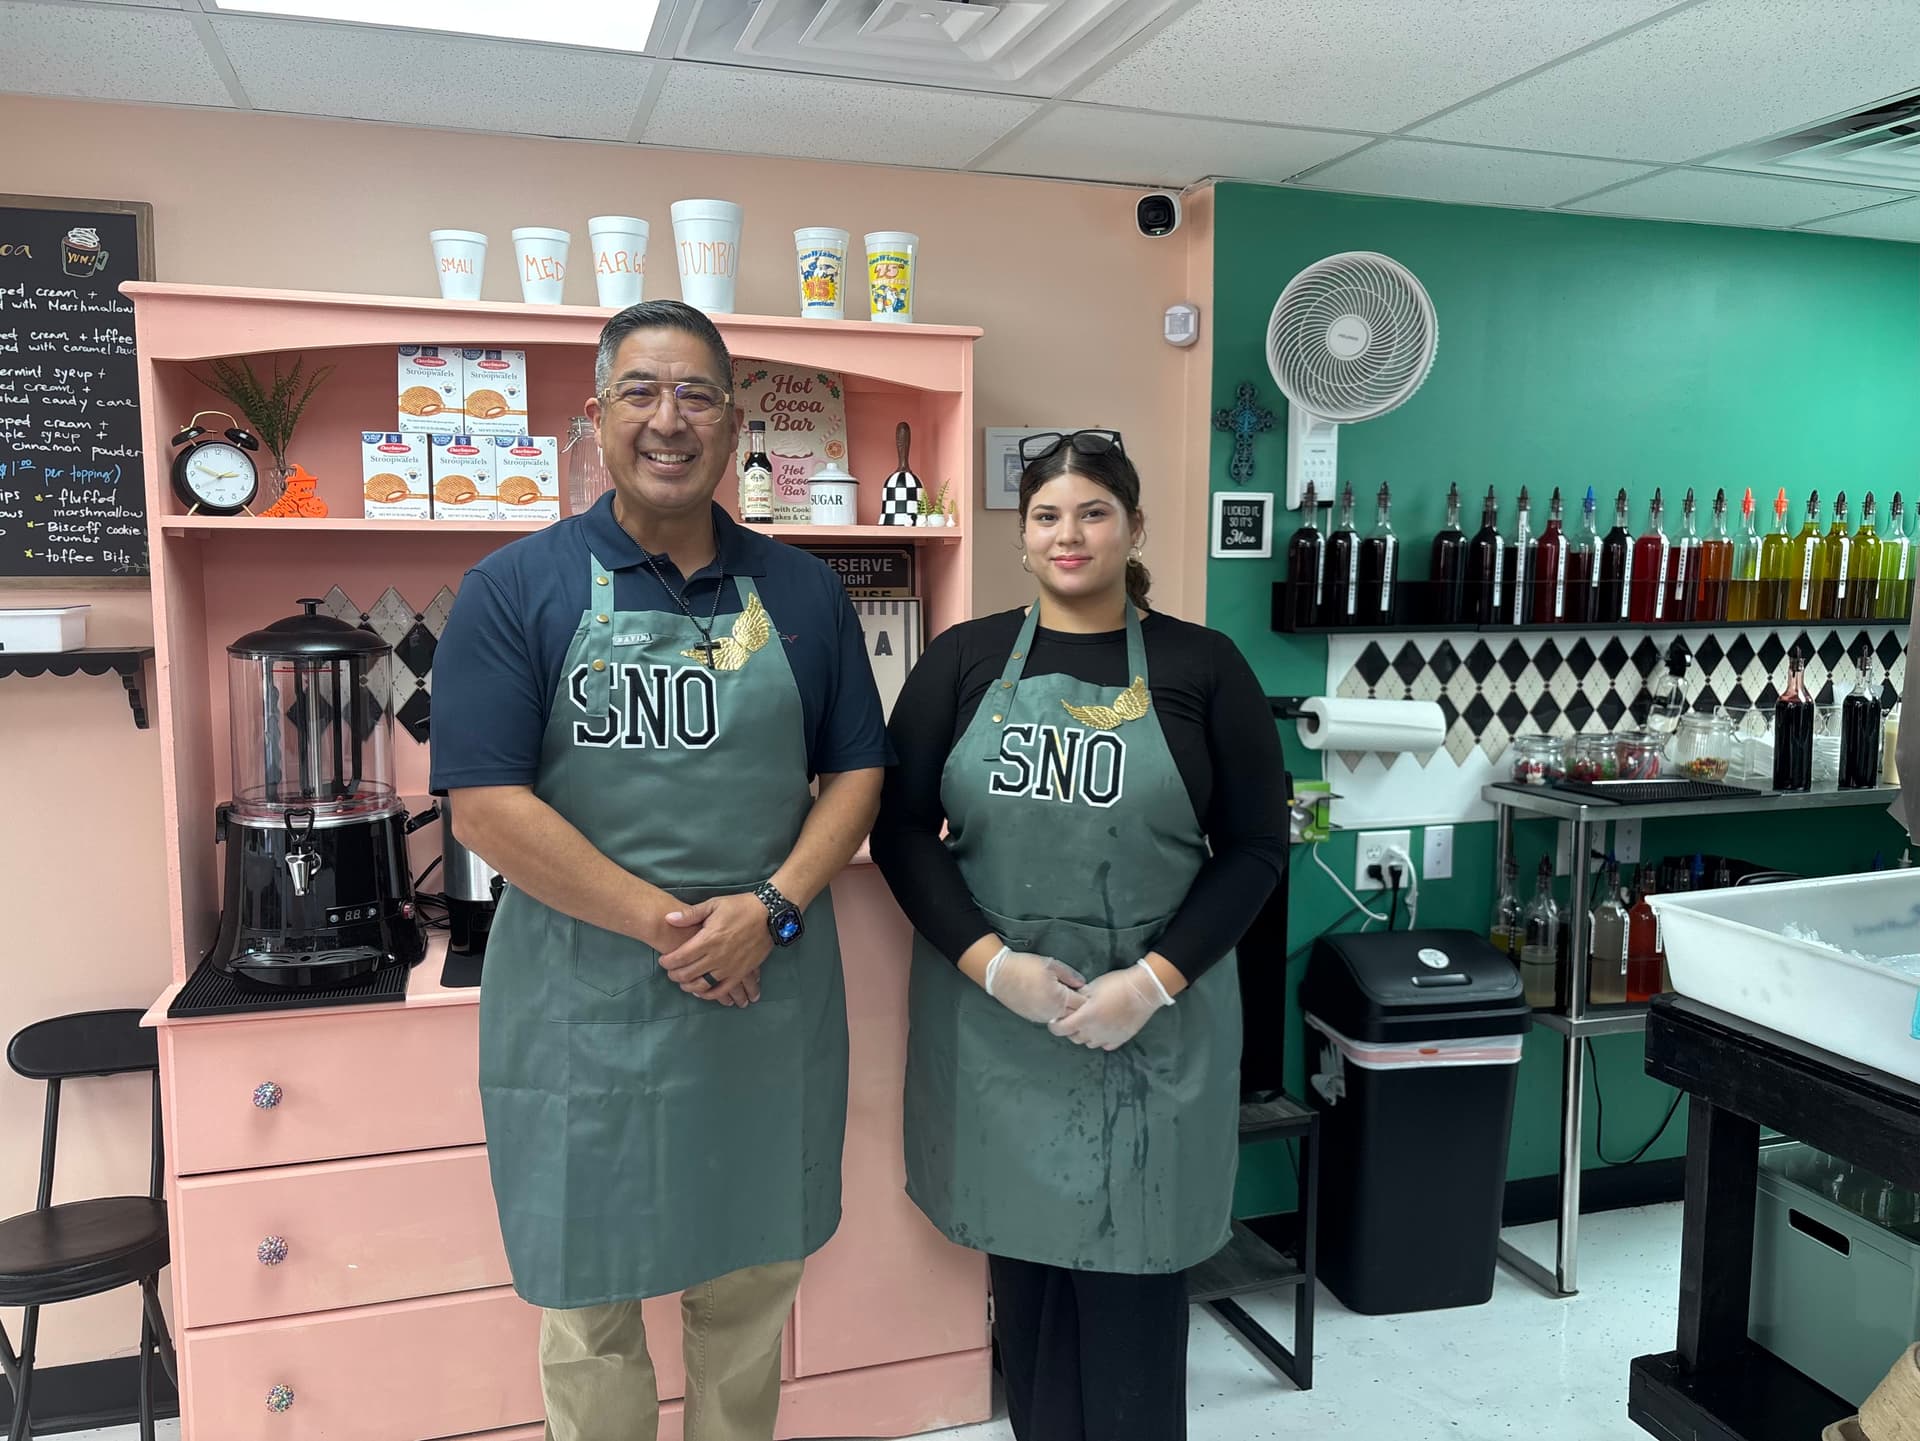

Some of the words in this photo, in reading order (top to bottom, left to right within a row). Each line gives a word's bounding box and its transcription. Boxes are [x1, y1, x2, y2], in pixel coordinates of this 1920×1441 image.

[0, 244, 32, 259] oa
[67, 252, 97, 266] YUM!
[681, 241, 736, 278] JUMBO
[525, 254, 566, 282] MED
[36, 287, 79, 299] cream
[12, 298, 37, 310] with
[30, 331, 69, 341] cream
[93, 328, 134, 344] toffee
[28, 342, 56, 351] with
[63, 343, 111, 355] caramel
[0, 365, 41, 378] ermint
[406, 368, 454, 378] Stroopwafels
[471, 371, 517, 381] Stroopwafels
[23, 383, 75, 394] cream
[772, 374, 814, 394] Hot
[42, 395, 88, 413] candy
[96, 398, 139, 408] cane
[760, 392, 825, 413] Cocoa
[44, 420, 92, 430] cream
[770, 412, 815, 432] Bar
[91, 444, 144, 461] powder
[370, 455, 419, 466] Stroopwafels
[440, 457, 487, 468] Stroopwafels
[503, 458, 549, 468] Stroopwafels
[781, 464, 805, 476] Hot
[45, 468, 64, 487] per
[781, 485, 807, 496] Bar
[811, 494, 843, 506] SUGAR
[53, 505, 144, 518] marshmallow
[773, 505, 791, 513] with
[1227, 505, 1251, 516] LICKED
[48, 521, 102, 535] Biscoff
[106, 525, 142, 536] cookie
[1229, 517, 1239, 527] SO
[48, 534, 101, 544] crumbs
[1225, 529, 1256, 545] Mine
[103, 549, 131, 563] Bits
[827, 558, 893, 572] ESERVE
[842, 574, 873, 585] IGHT
[568, 663, 720, 750] SNO
[989, 723, 1127, 808] SNO
